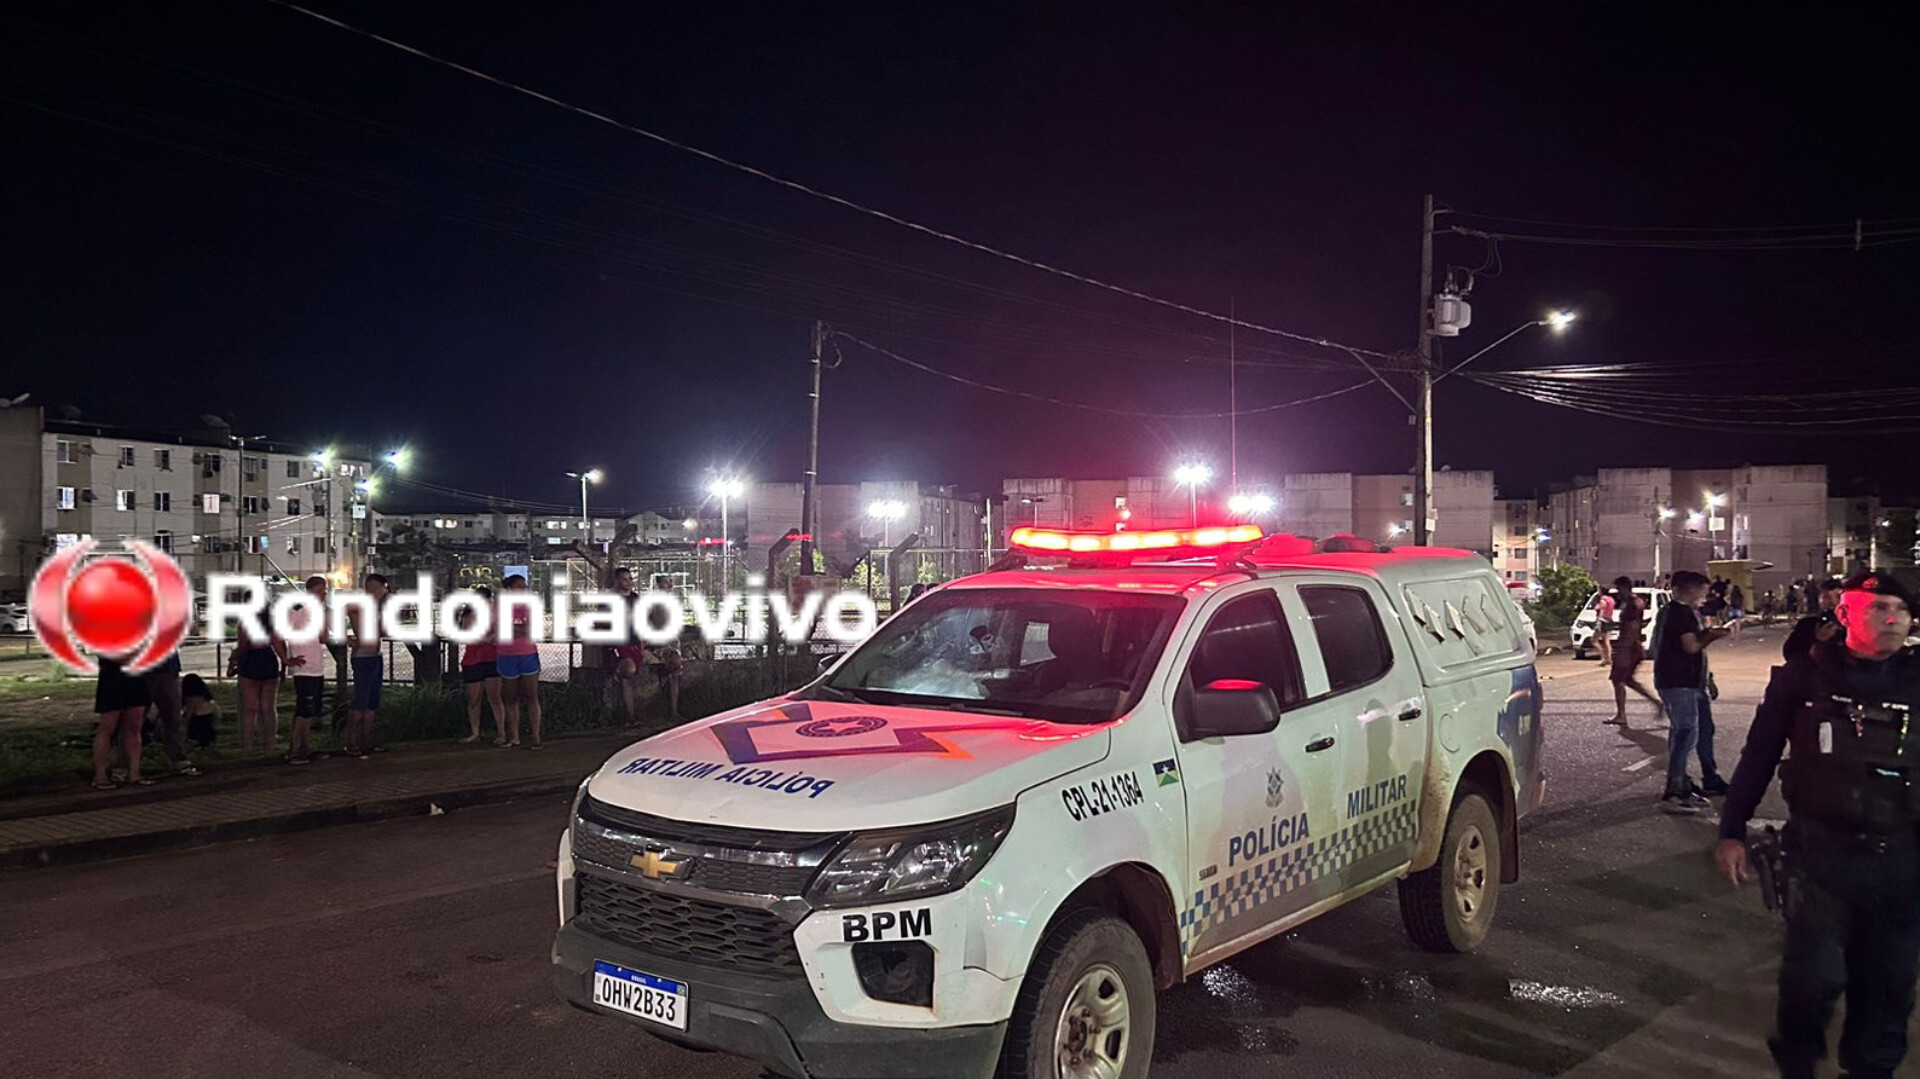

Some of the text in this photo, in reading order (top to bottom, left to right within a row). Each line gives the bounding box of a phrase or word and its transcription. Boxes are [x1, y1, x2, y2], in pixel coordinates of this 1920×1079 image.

[1061, 771, 1145, 822] CPL-21-1364
[1228, 774, 1407, 867] POLÍCIA MILITAR
[842, 908, 932, 942] BPM
[602, 977, 677, 1022] OHW2B33
